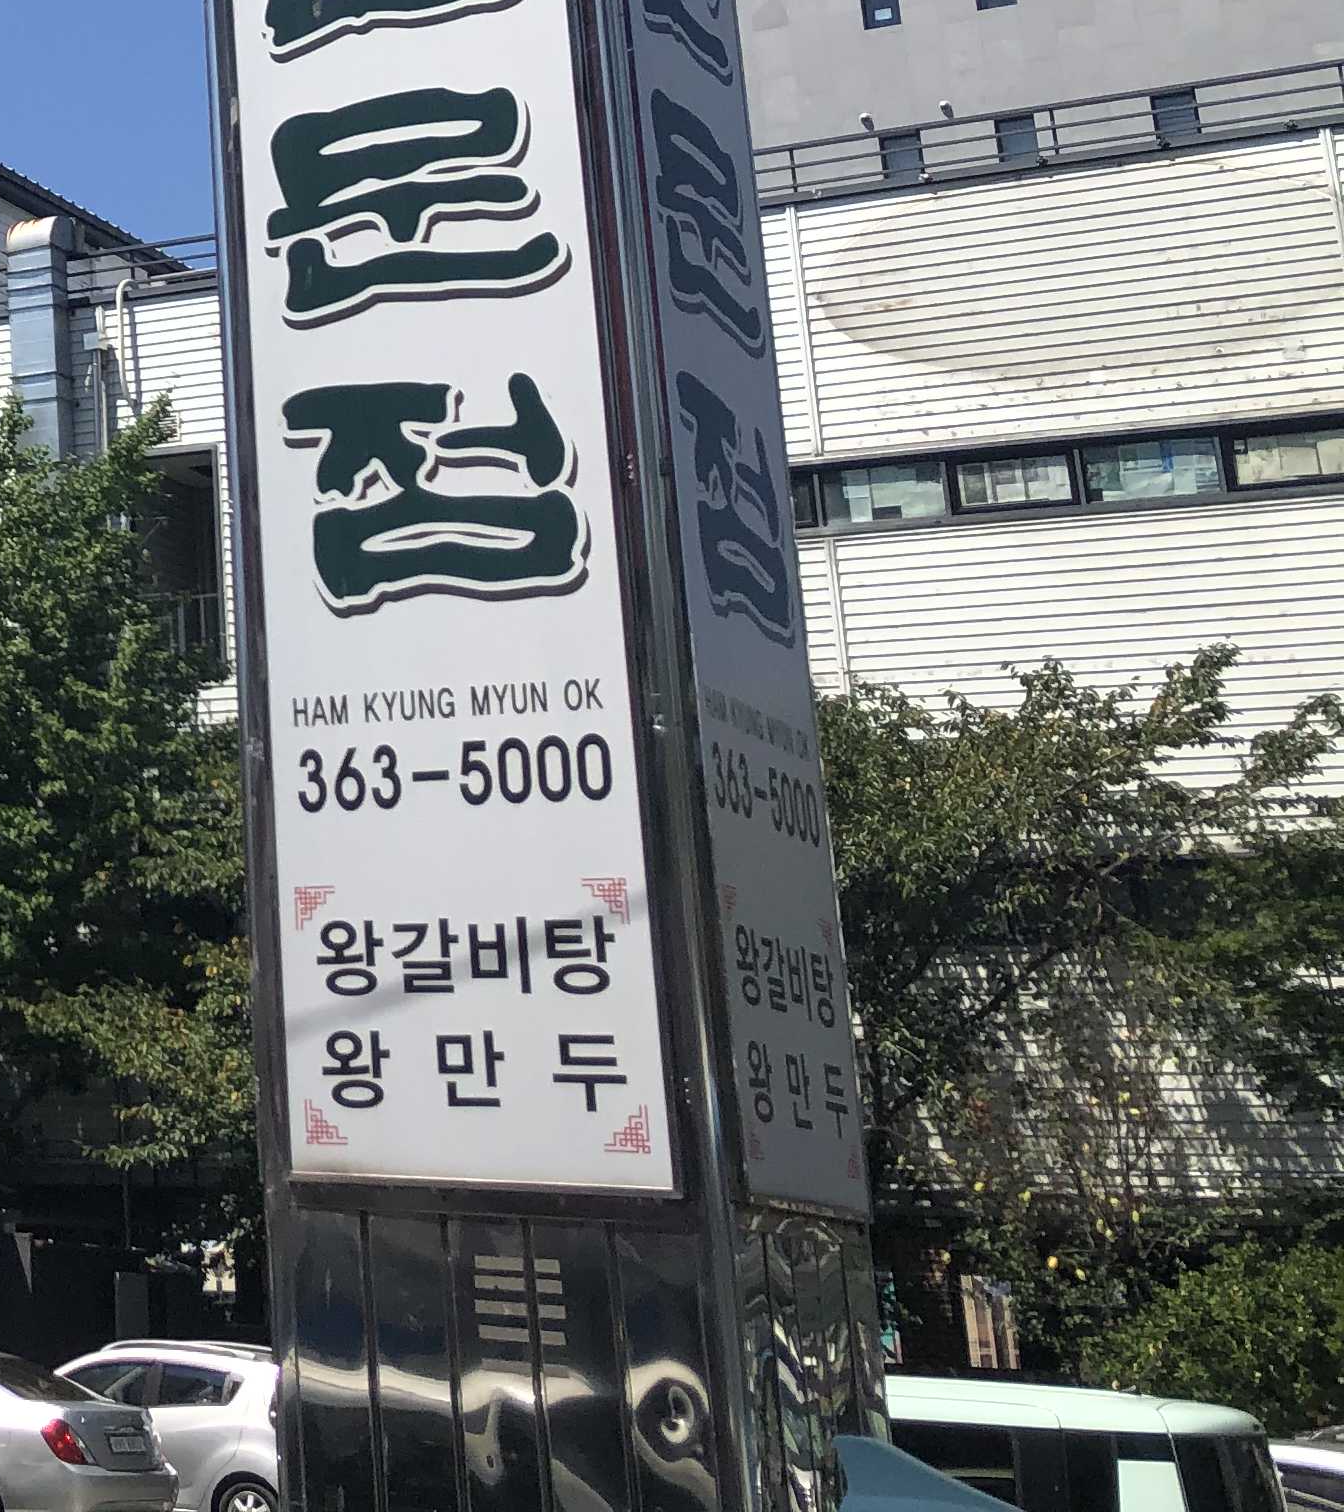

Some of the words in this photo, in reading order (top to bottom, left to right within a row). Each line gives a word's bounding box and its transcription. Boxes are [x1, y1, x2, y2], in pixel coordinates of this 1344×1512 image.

[292, 693, 349, 728] HAM
[363, 687, 456, 723] KYUNG
[471, 682, 548, 717] MYUN
[563, 678, 605, 712] OK
[297, 732, 613, 814] 363-5000
[712, 743, 821, 848] 363-5000
[316, 914, 616, 996] 왕갈비탕
[735, 922, 837, 1030] 왕갈비탕
